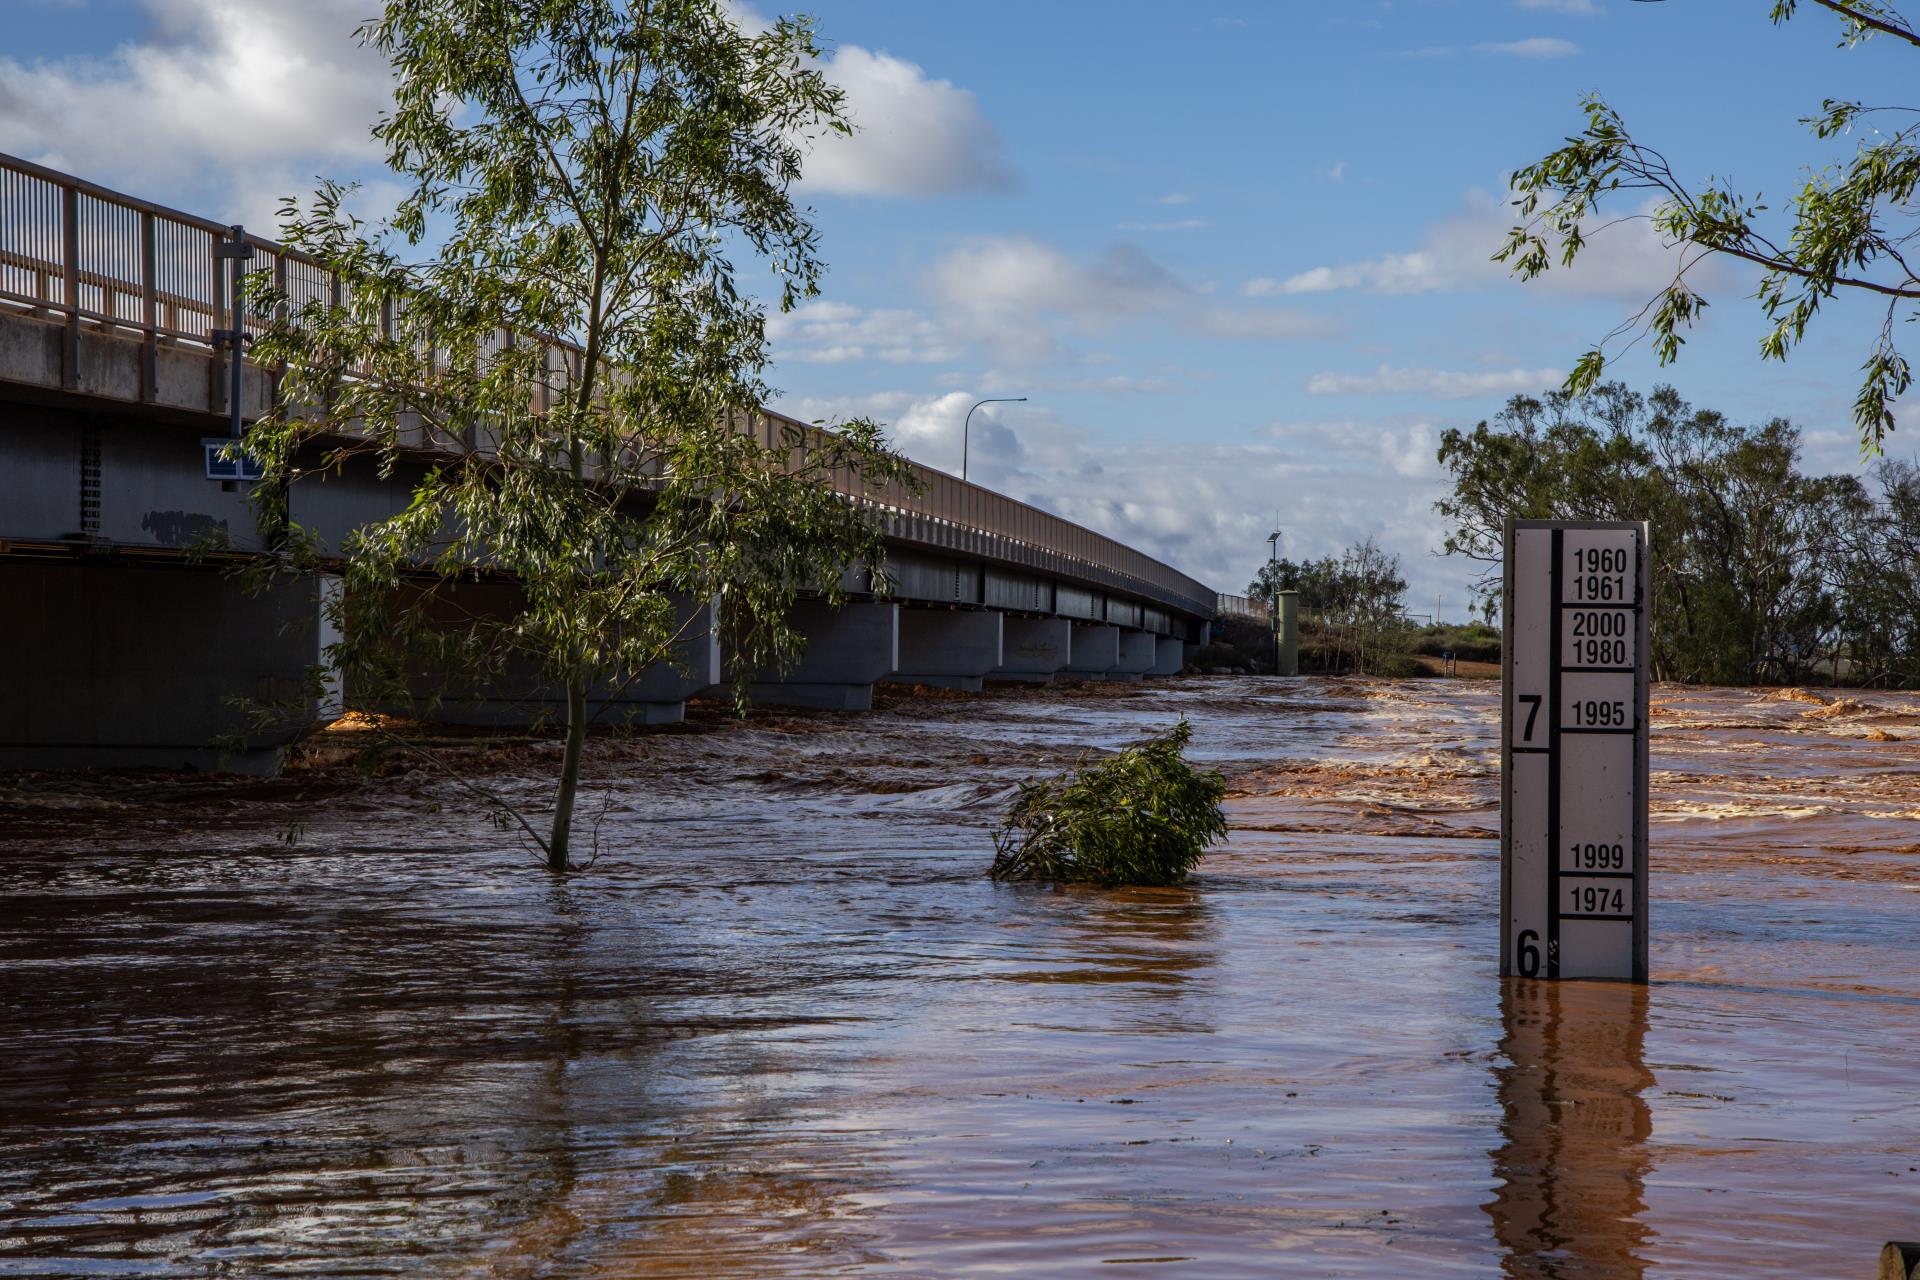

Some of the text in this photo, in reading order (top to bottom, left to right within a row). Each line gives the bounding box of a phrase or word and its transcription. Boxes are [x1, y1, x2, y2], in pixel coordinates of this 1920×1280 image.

[1573, 548, 1627, 573] 1960
[1573, 575, 1624, 601] 1961
[1572, 612, 1626, 637] 2000
[1572, 639, 1626, 664] 1980
[1518, 694, 1542, 742] 7
[1571, 701, 1625, 726] 1995
[1571, 843, 1624, 869] 1999
[1570, 887, 1624, 912] 1974
[1516, 929, 1540, 978] 6
